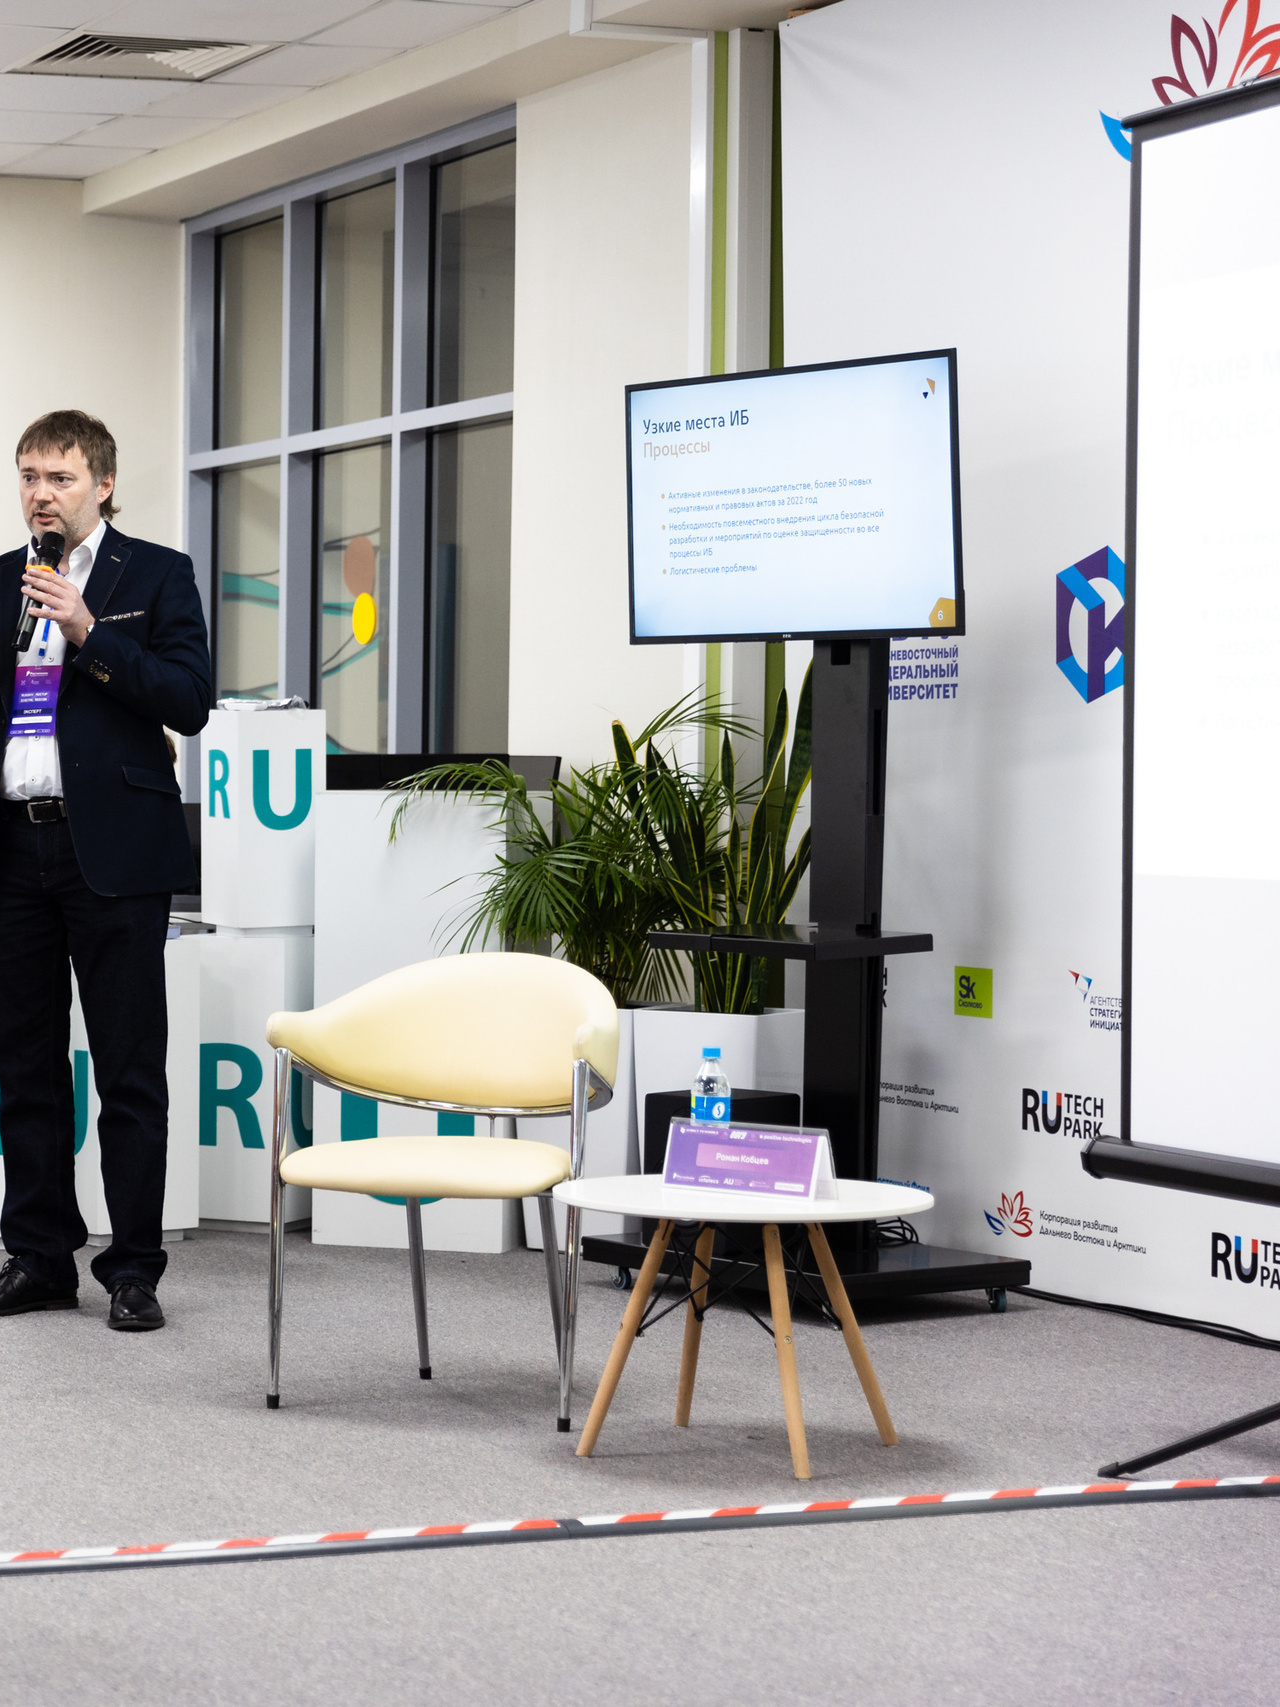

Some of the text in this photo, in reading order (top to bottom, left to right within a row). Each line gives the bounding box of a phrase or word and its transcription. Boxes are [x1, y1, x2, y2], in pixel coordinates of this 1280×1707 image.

[642, 409, 749, 435] Узкие места ИБ
[643, 441, 710, 460] Процессы
[668, 491, 701, 500] Активные
[703, 488, 740, 497] изменения
[814, 479, 836, 489] более
[838, 478, 847, 488] 50
[849, 478, 872, 486] новых
[668, 504, 714, 514] нормативных
[721, 502, 754, 511] правовых
[756, 499, 776, 507] актов
[787, 496, 803, 505] 2022
[805, 496, 818, 504] год
[669, 508, 884, 531] Необходимость повсеместного внедрения цикла безопасной
[669, 534, 707, 545] разработки
[715, 531, 761, 542] мероприятий
[763, 531, 772, 539] по
[773, 530, 798, 539] оценке
[800, 526, 855, 537] защищенности
[856, 526, 865, 534] во
[867, 525, 880, 533] все
[669, 547, 713, 560] процессы ИБ
[669, 563, 757, 576] Логистические проблемы
[937, 609, 944, 621] 6
[904, 1084, 935, 1095] развития
[896, 1095, 924, 1108] Востока
[930, 1101, 959, 1113] Арктики
[1022, 1088, 1104, 1134] RU TECH
[1063, 1116, 1103, 1140] PARK
[715, 1152, 769, 1165] Роман Кобцев
[1039, 1210, 1118, 1234] Корпорация развития
[1039, 1225, 1147, 1254] Дальнего Востока и Арктики
[1211, 1232, 1258, 1284] RU
